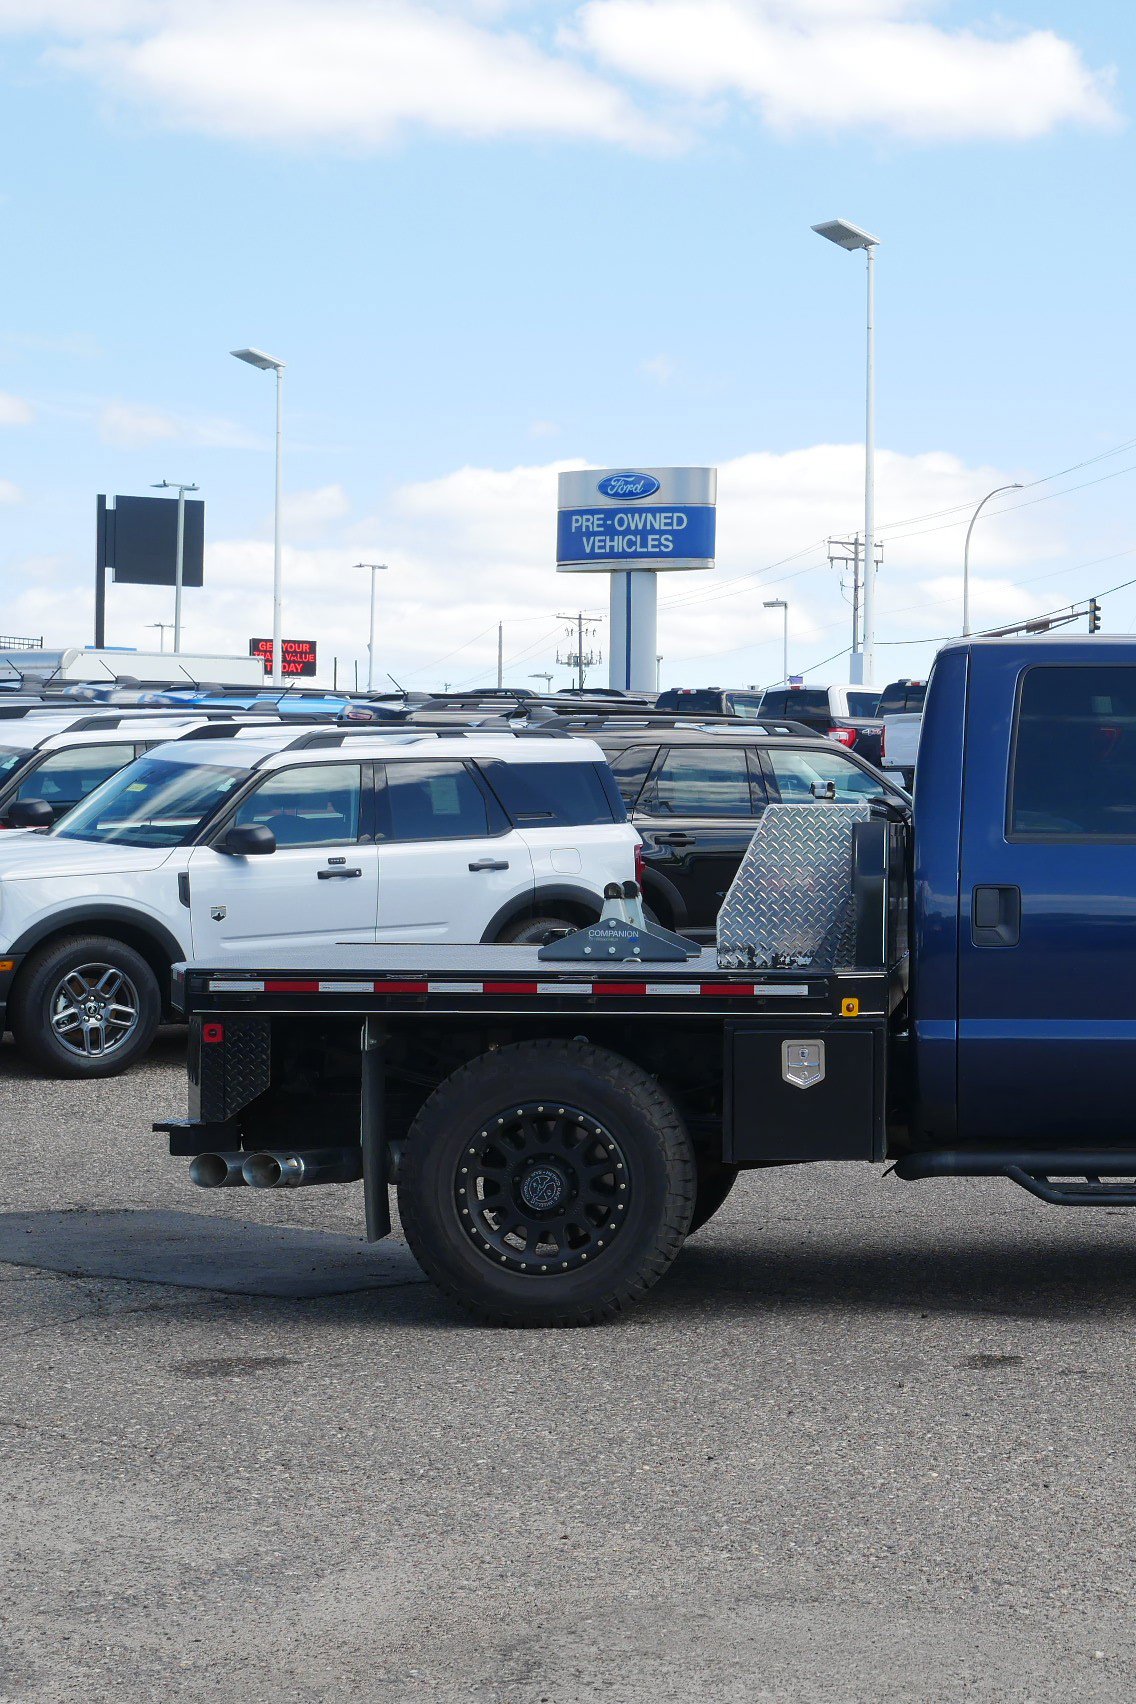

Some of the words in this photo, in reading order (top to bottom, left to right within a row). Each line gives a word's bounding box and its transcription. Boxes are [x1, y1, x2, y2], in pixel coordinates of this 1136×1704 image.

[607, 476, 644, 495] Ford
[571, 512, 688, 533] PRE-OWNED
[582, 534, 674, 554] VEHICLES
[281, 642, 310, 652] YOUR
[285, 652, 315, 662] VALUE
[265, 662, 304, 673] TDAY
[588, 929, 639, 938] COMPANION
